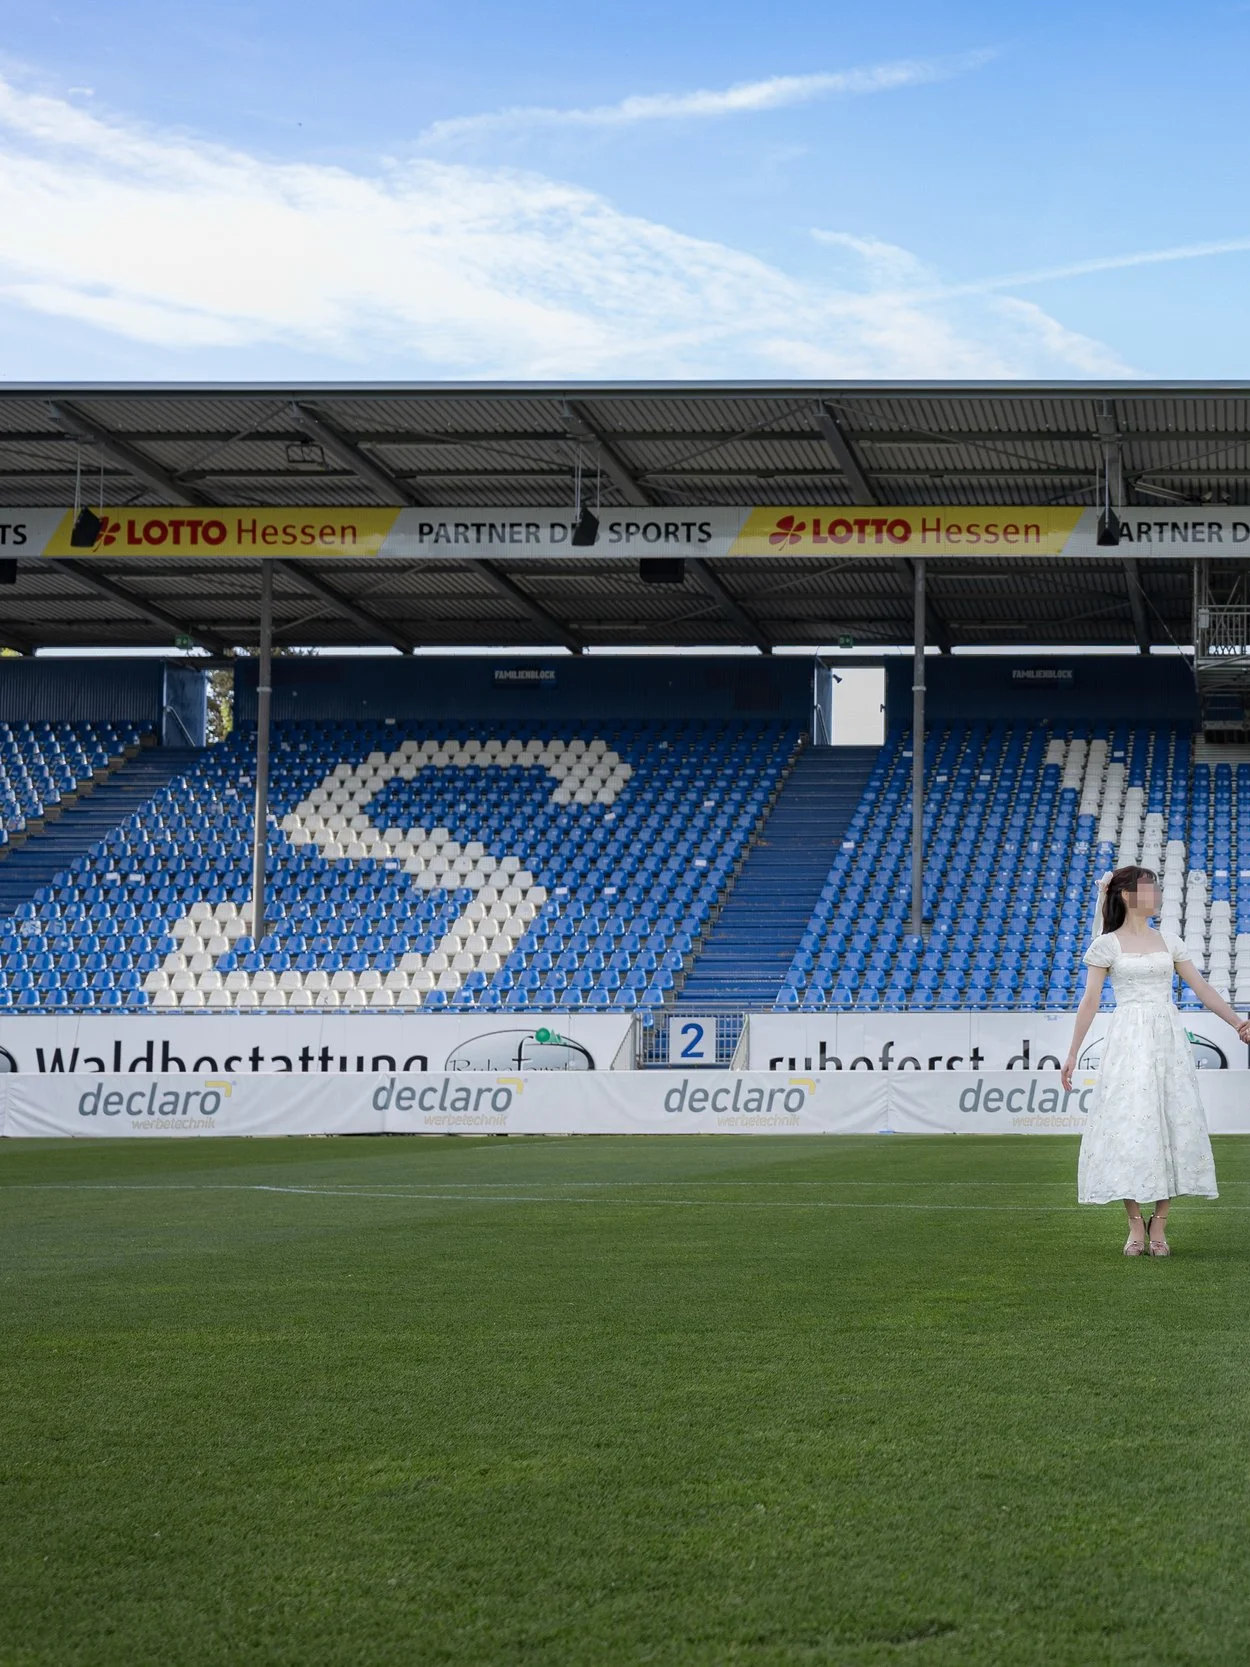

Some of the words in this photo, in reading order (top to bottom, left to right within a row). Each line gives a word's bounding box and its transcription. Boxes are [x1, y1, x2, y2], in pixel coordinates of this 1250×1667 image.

[127, 519, 227, 545] LOTTO
[236, 518, 357, 545] Hessen
[418, 522, 541, 544] PARTNER
[608, 522, 712, 544] SPORTS
[812, 518, 912, 544] LOTTO
[921, 517, 1040, 544] Hessen
[1119, 521, 1223, 543] ARTNER
[680, 1022, 705, 1058] 2
[78, 1081, 222, 1116] declaro
[372, 1077, 513, 1112] declaro
[664, 1078, 805, 1113] declaro
[131, 1116, 215, 1130] werbetechnik
[716, 1114, 800, 1127] werbetechnik
[1012, 1115, 1089, 1128] werbetechni
